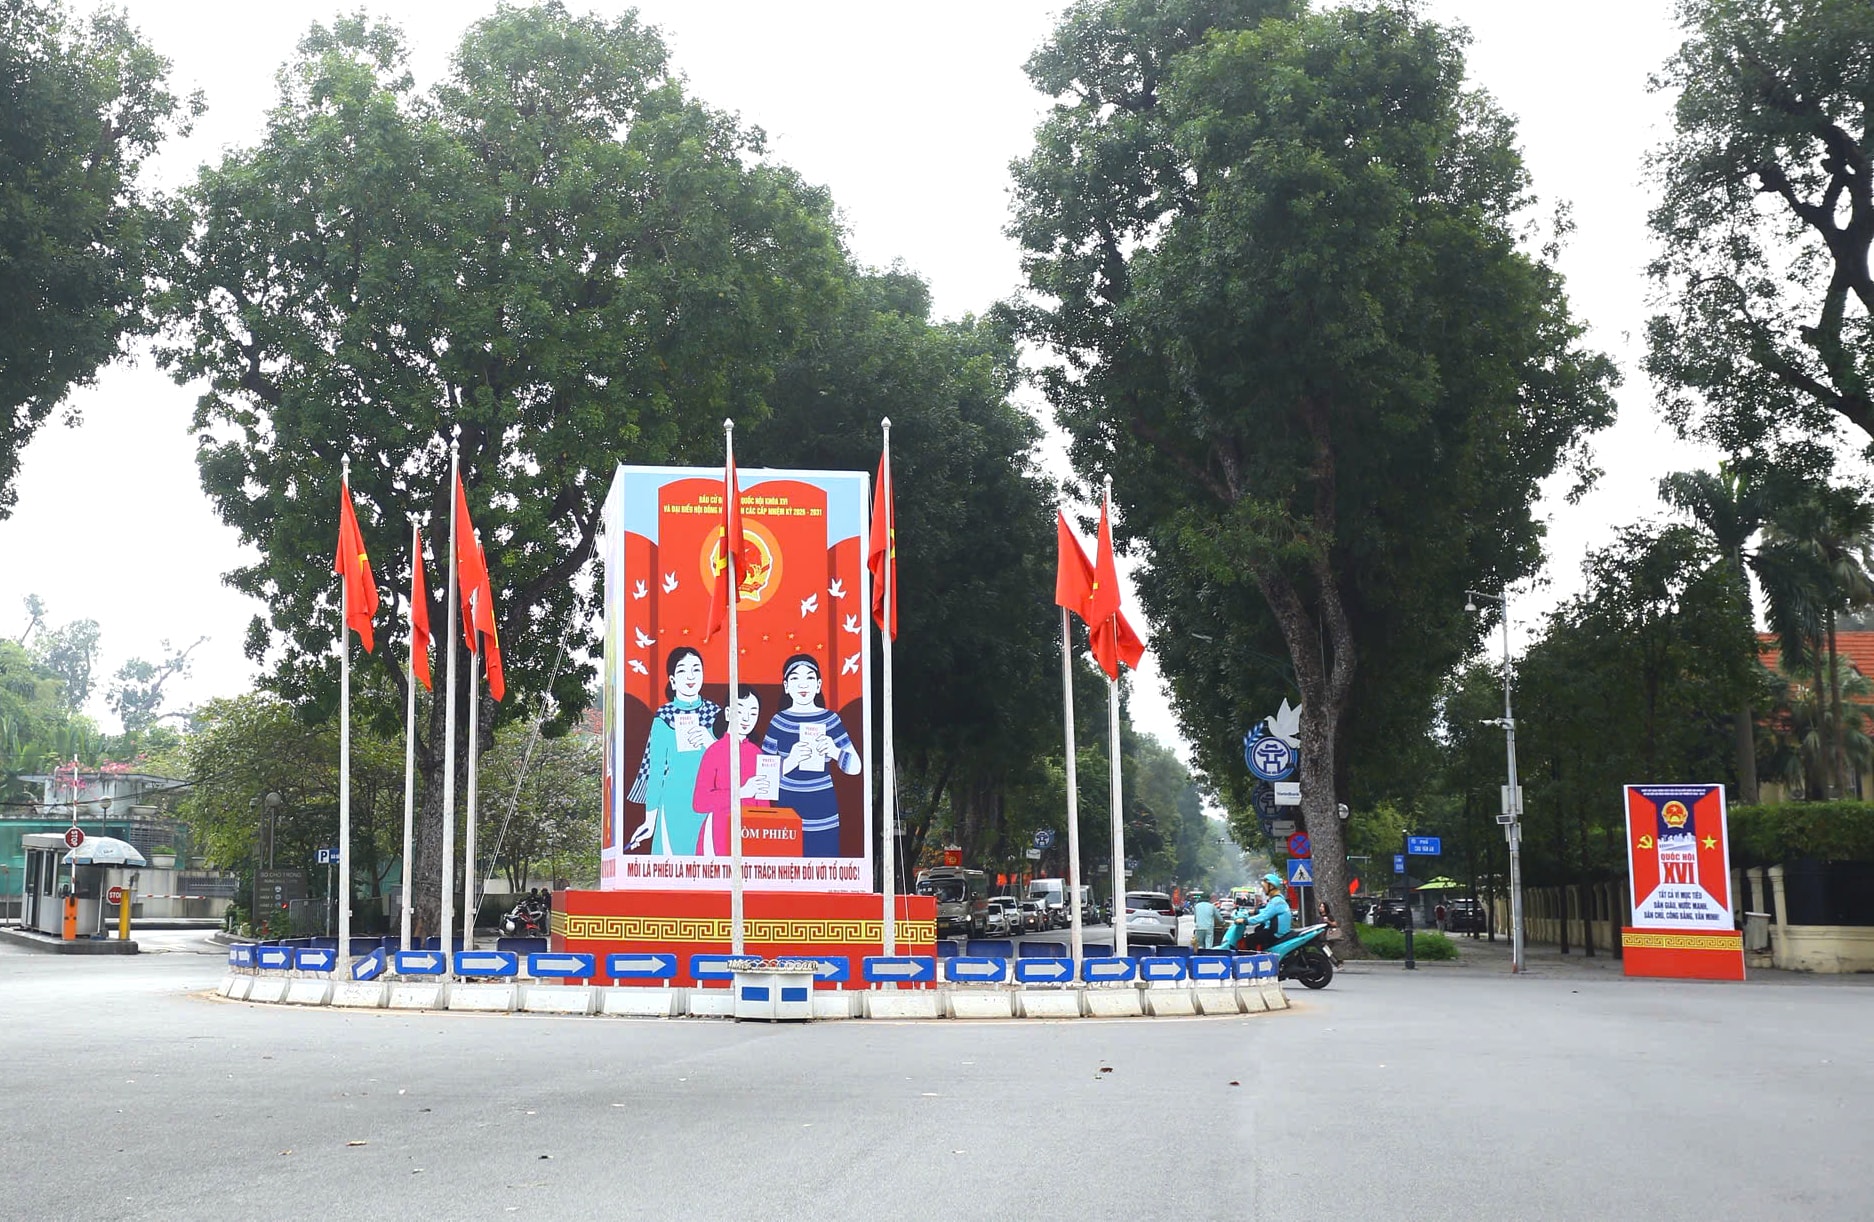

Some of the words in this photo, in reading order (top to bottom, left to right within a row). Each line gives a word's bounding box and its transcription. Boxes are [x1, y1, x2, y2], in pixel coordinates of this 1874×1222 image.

[664, 504, 671, 513] VÀ
[745, 506, 756, 515] CÁC
[756, 506, 767, 515] CẤP
[741, 825, 760, 839] ÒM
[762, 826, 797, 840] PHIẾU
[320, 850, 328, 862] P
[1660, 852, 1681, 861] QUỐC
[1682, 853, 1696, 861] HỘI
[627, 857, 641, 878] MỖI
[642, 859, 652, 878] LÁ
[652, 857, 674, 878] PHIẾU
[675, 860, 684, 879] LÀ
[685, 860, 701, 882] MỘT
[754, 861, 777, 880] TRÁCH
[777, 861, 800, 883] NHIỆM
[802, 859, 814, 881] ĐỐI
[815, 861, 827, 881] VỚI
[828, 859, 838, 881] TỔ
[838, 860, 860, 882] QUỐC!
[1661, 861, 1697, 885] XVI
[109, 890, 122, 899] STO
